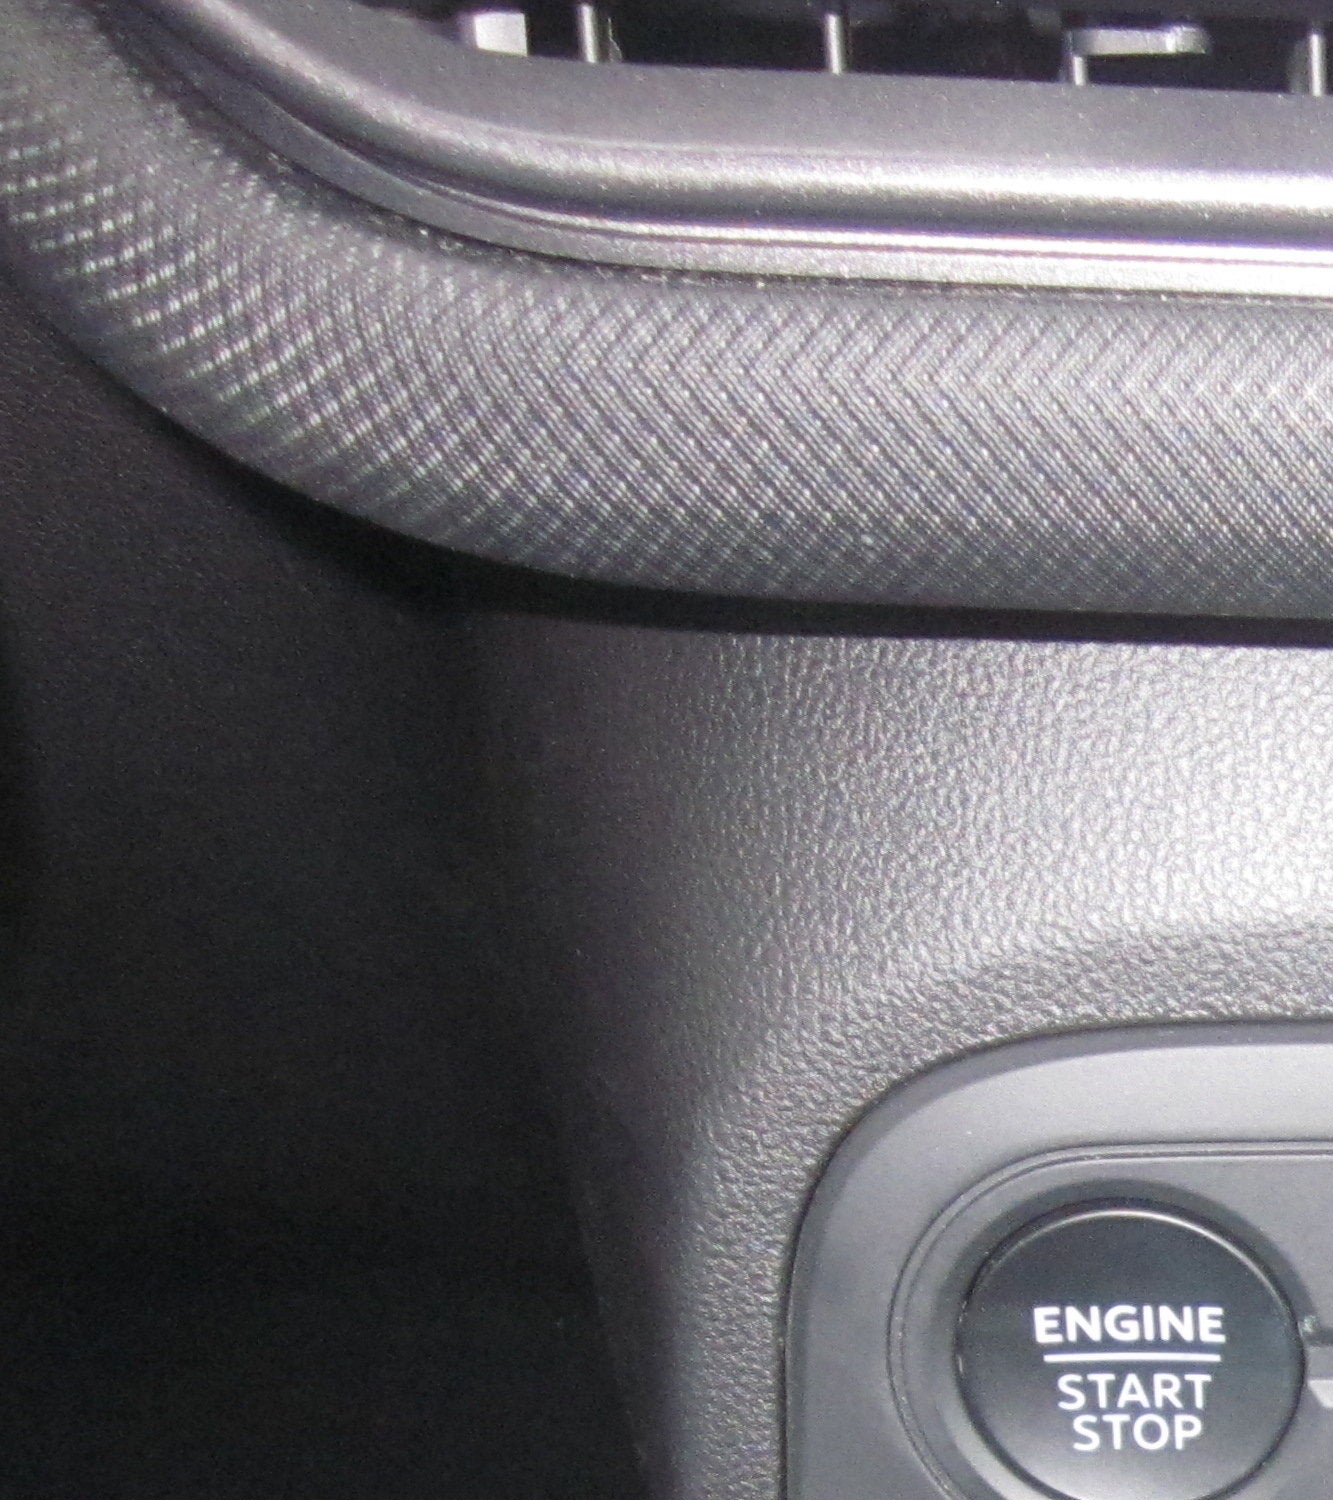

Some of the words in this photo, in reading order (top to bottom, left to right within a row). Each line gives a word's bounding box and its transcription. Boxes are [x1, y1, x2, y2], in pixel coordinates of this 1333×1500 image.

[1033, 1304, 1226, 1344] ENGINE
[1057, 1373, 1212, 1410] START
[1073, 1413, 1202, 1451] STOP
